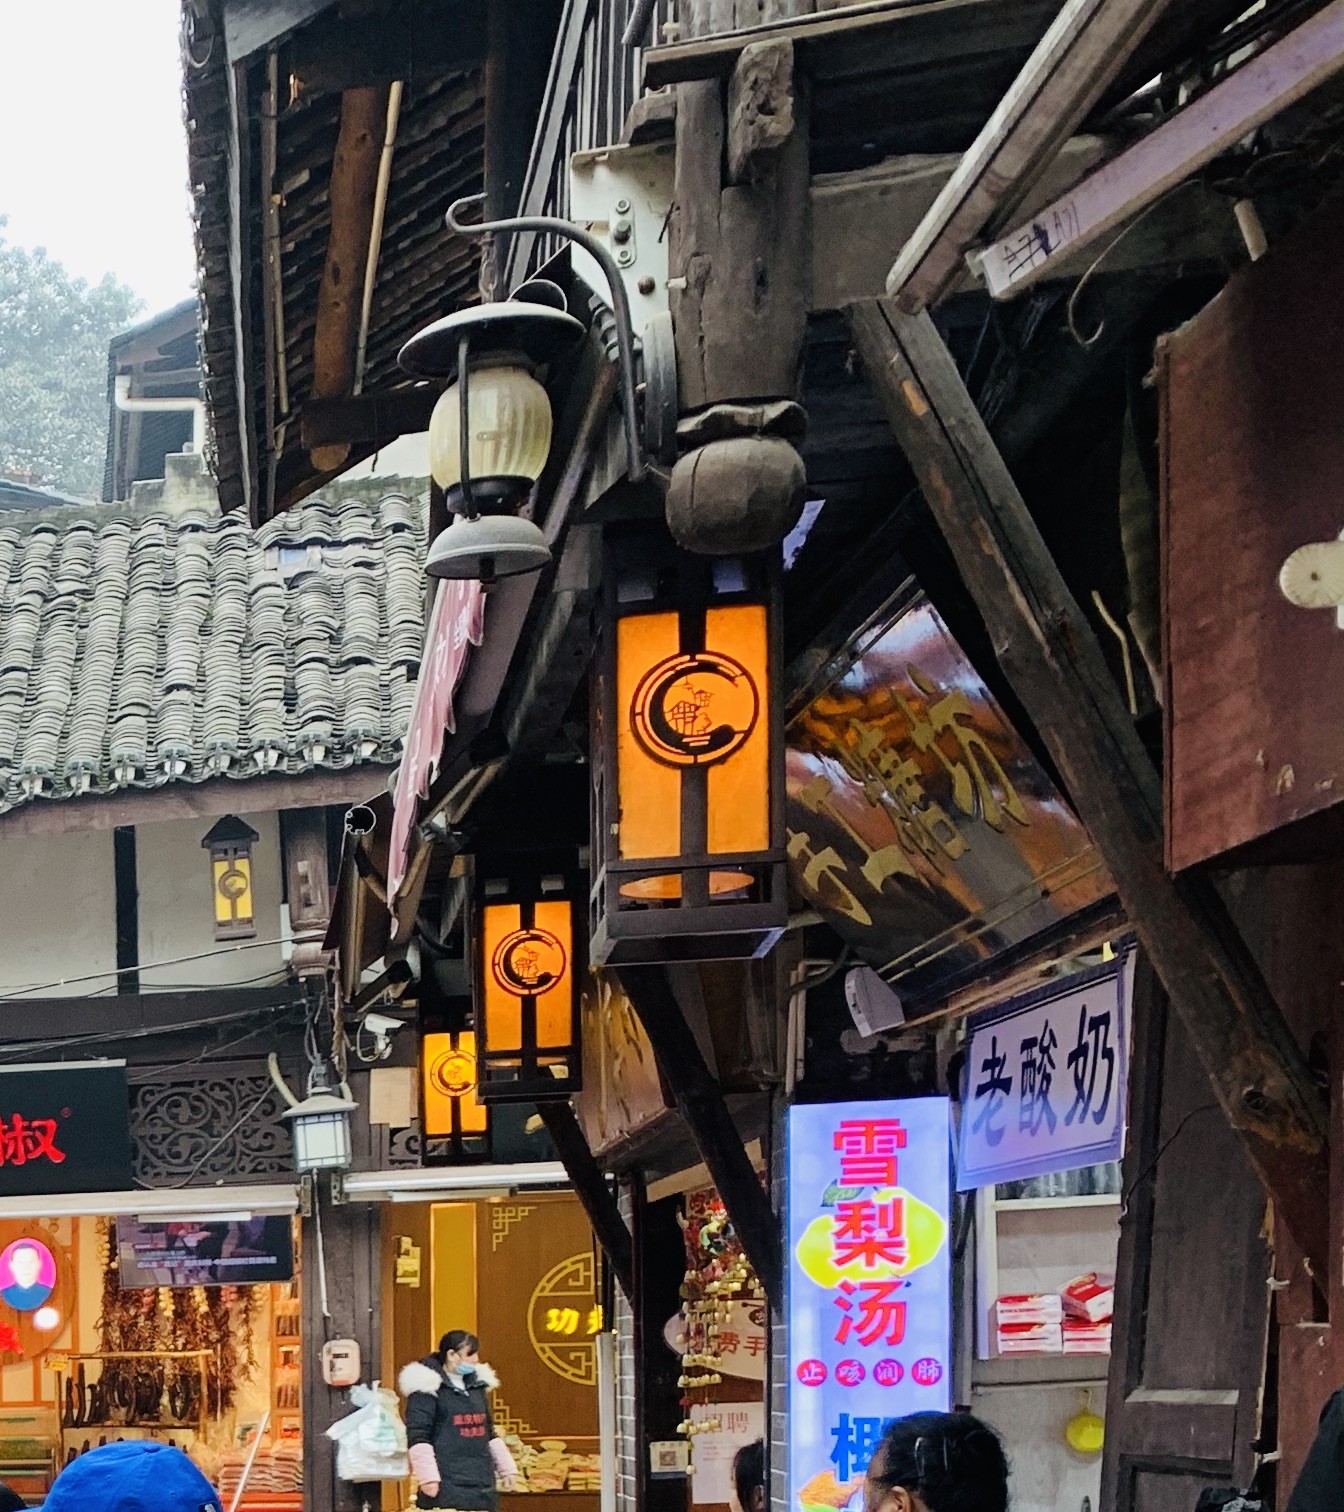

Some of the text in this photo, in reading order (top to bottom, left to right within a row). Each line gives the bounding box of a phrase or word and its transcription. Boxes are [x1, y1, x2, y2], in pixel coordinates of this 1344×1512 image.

[972, 1003, 1115, 1148] 老酸奶
[832, 1117, 910, 1348] 雪梨汤
[799, 1358, 943, 1387] 止咳润肺
